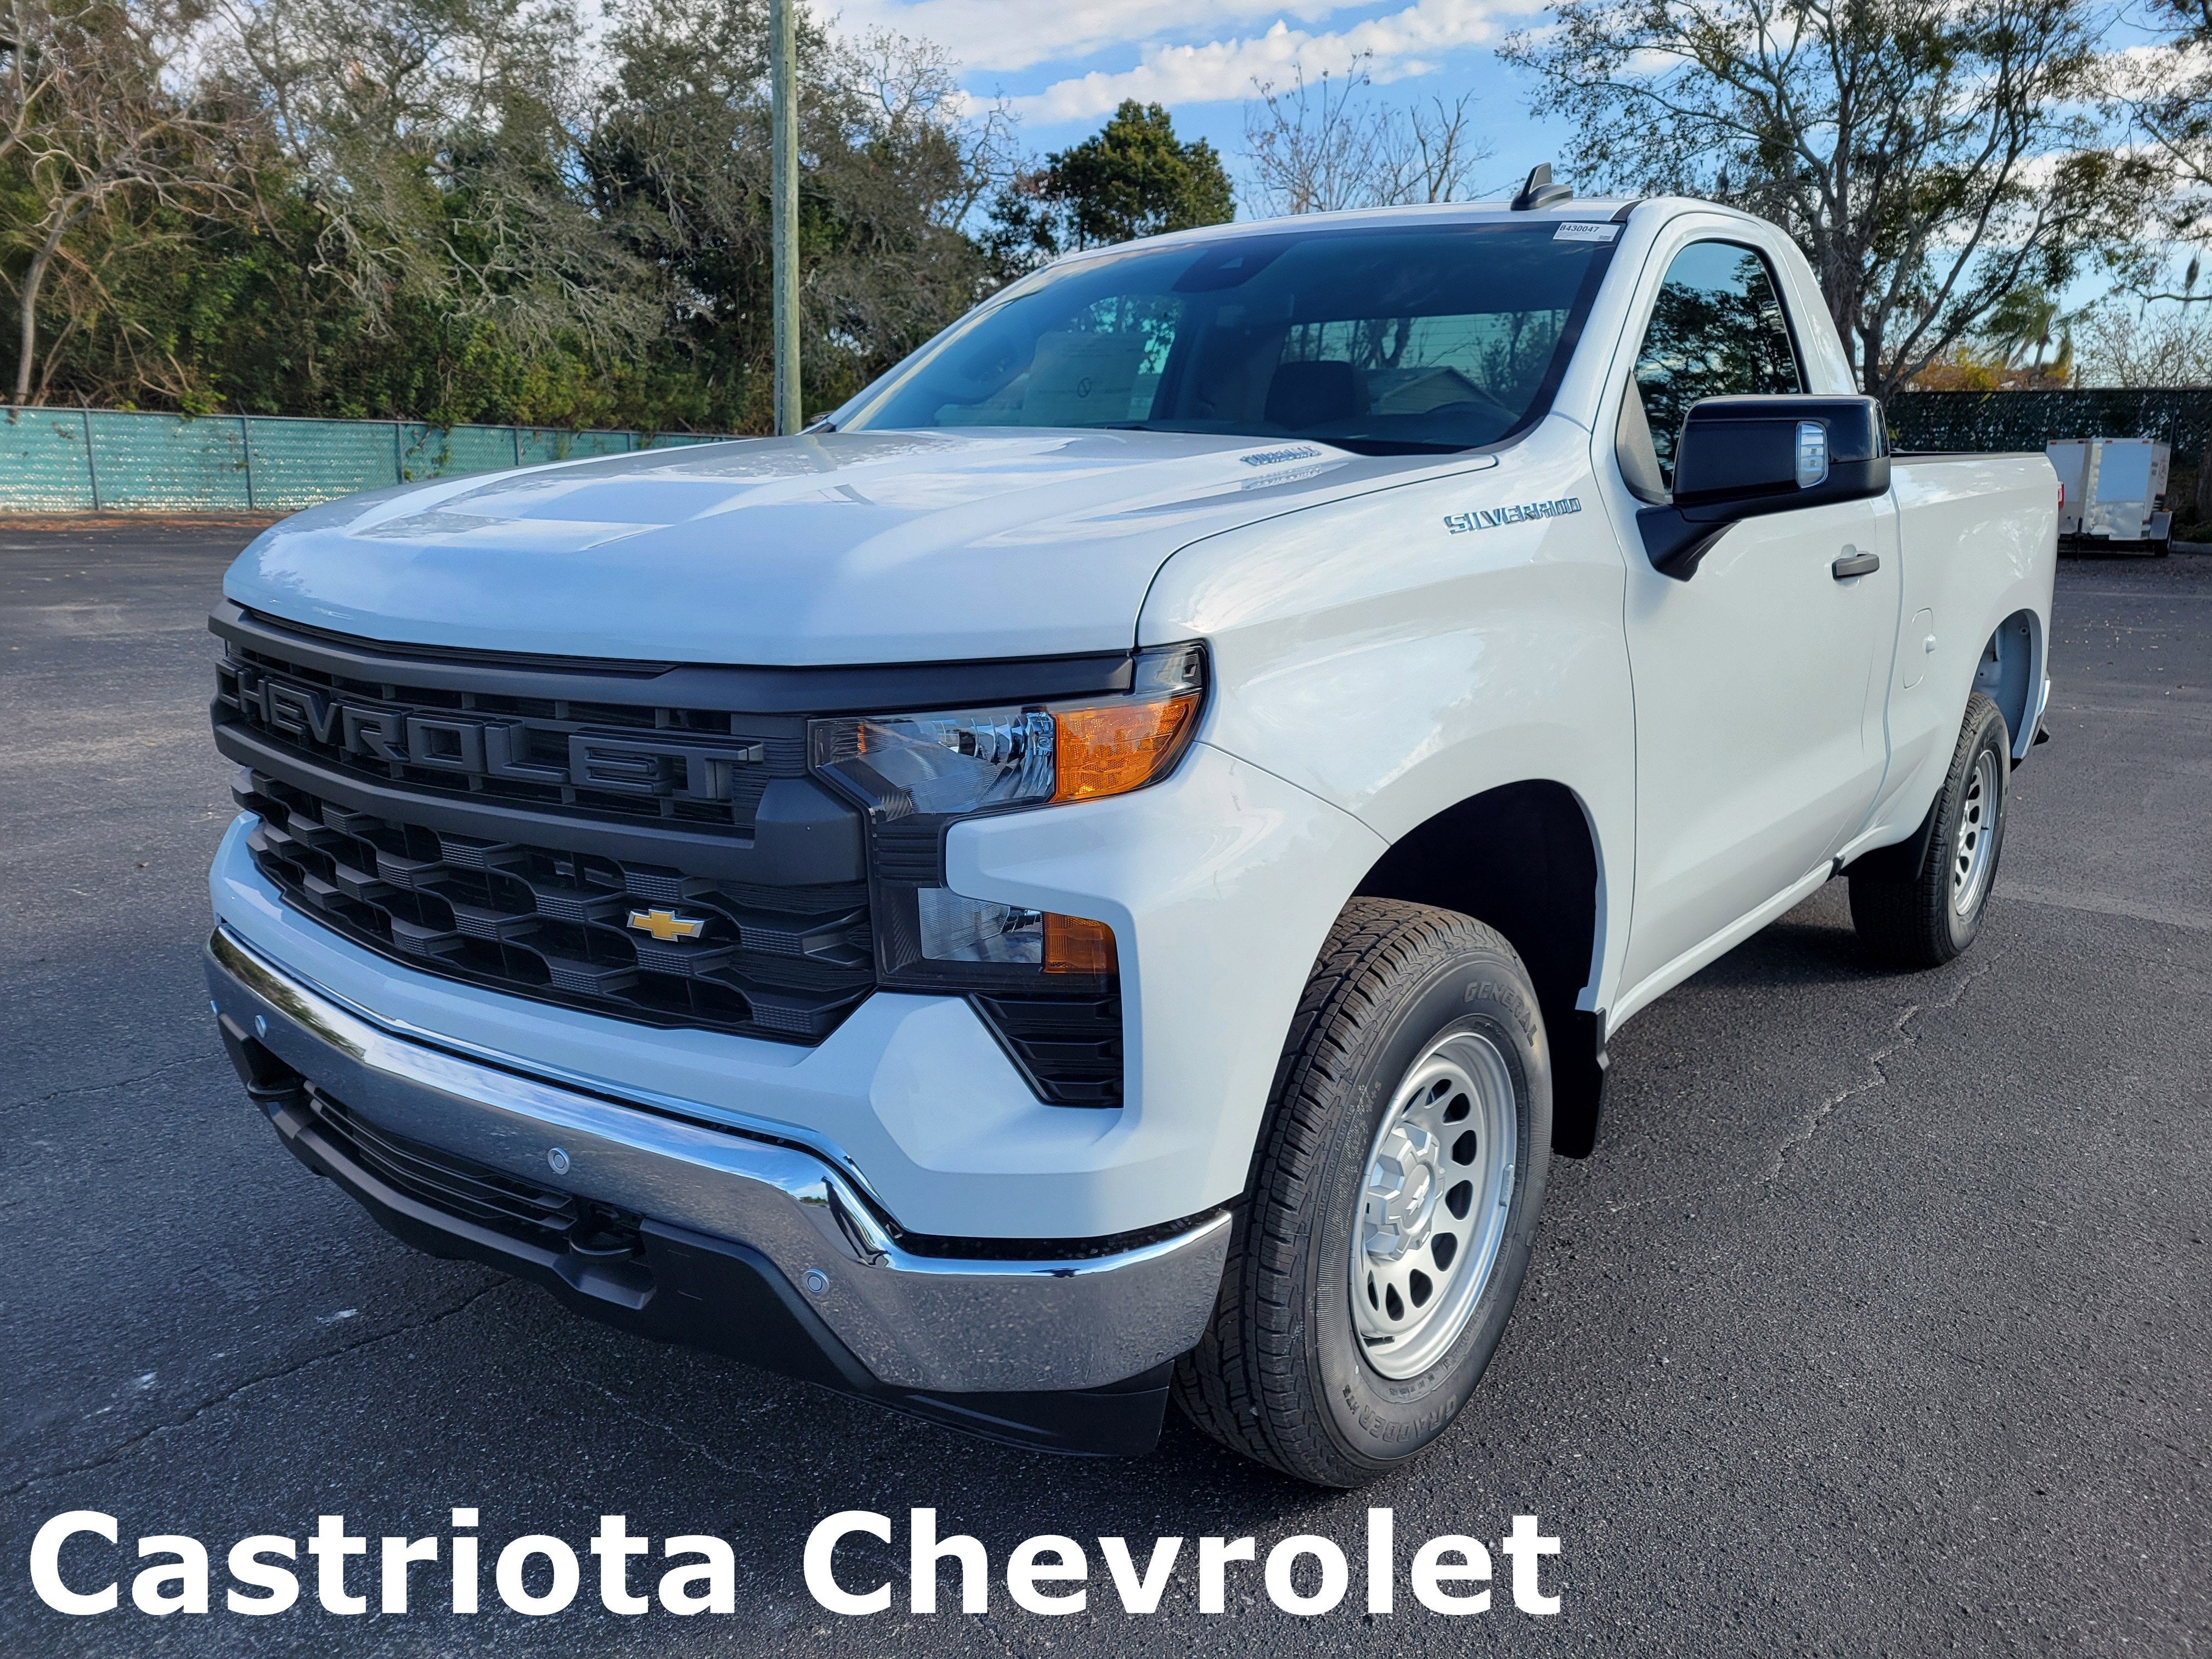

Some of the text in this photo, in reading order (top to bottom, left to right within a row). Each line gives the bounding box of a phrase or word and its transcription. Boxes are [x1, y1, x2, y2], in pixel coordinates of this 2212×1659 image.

[1559, 224, 1600, 233] B430047
[1443, 498, 1582, 535] SILVERADO
[215, 658, 764, 801] CHEVROLET
[1463, 981, 1537, 1047] GENERAL
